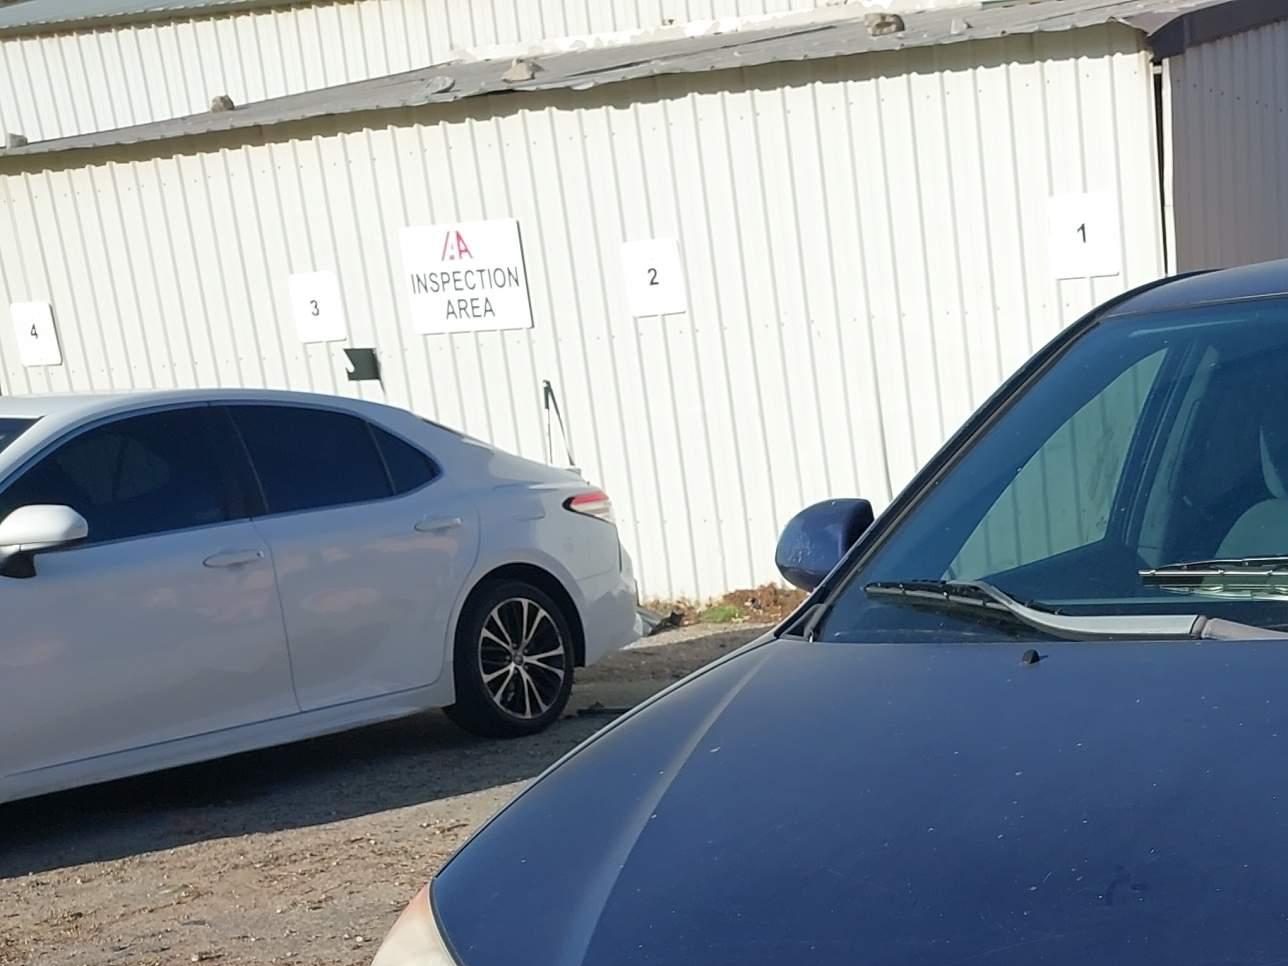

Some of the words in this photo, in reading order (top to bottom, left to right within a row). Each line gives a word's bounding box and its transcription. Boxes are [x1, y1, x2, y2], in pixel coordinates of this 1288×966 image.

[1077, 223, 1086, 243] 1
[410, 266, 520, 295] INSPECTION
[647, 267, 659, 286] 2
[309, 299, 320, 317] 3
[446, 296, 496, 320] AREA
[30, 323, 39, 340] 4
